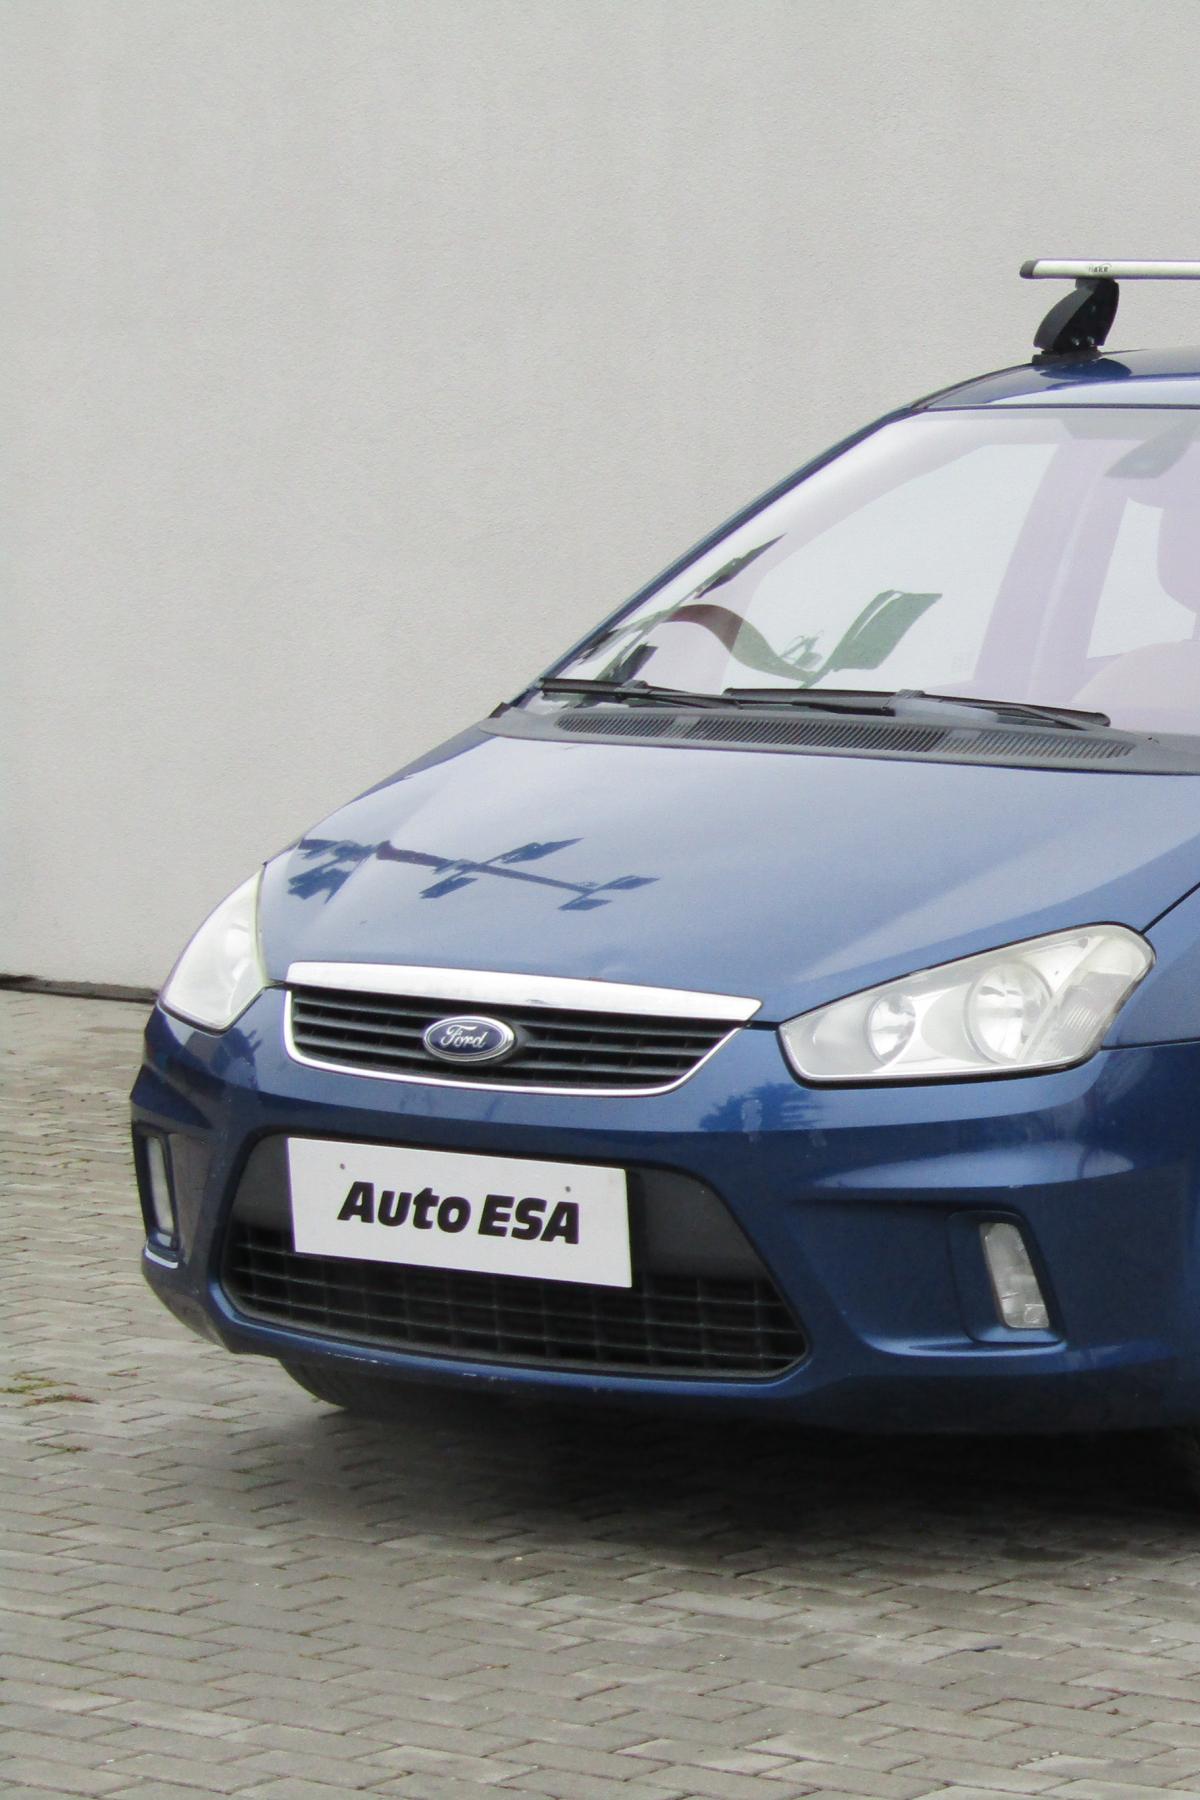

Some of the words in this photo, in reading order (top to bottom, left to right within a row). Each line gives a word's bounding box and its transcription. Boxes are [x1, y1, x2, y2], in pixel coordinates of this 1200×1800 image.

[440, 1024, 488, 1048] Ford
[337, 1181, 471, 1233] Auto
[478, 1194, 579, 1244] ESA
